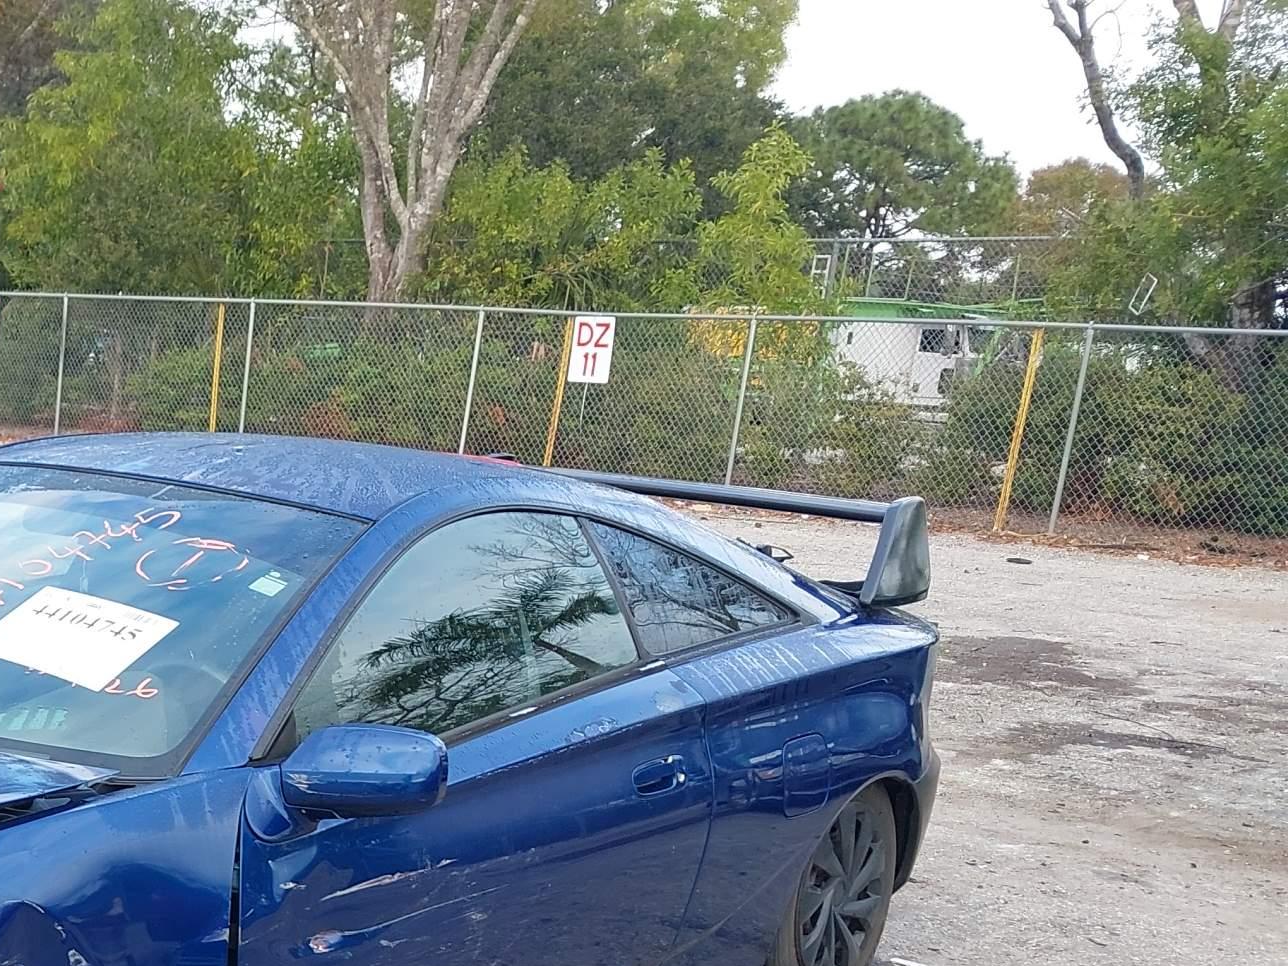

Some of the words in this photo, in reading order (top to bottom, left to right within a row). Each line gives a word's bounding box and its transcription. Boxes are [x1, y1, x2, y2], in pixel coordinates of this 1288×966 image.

[576, 322, 611, 348] DZ
[582, 351, 597, 377] 11
[32, 604, 143, 641] 44104745
